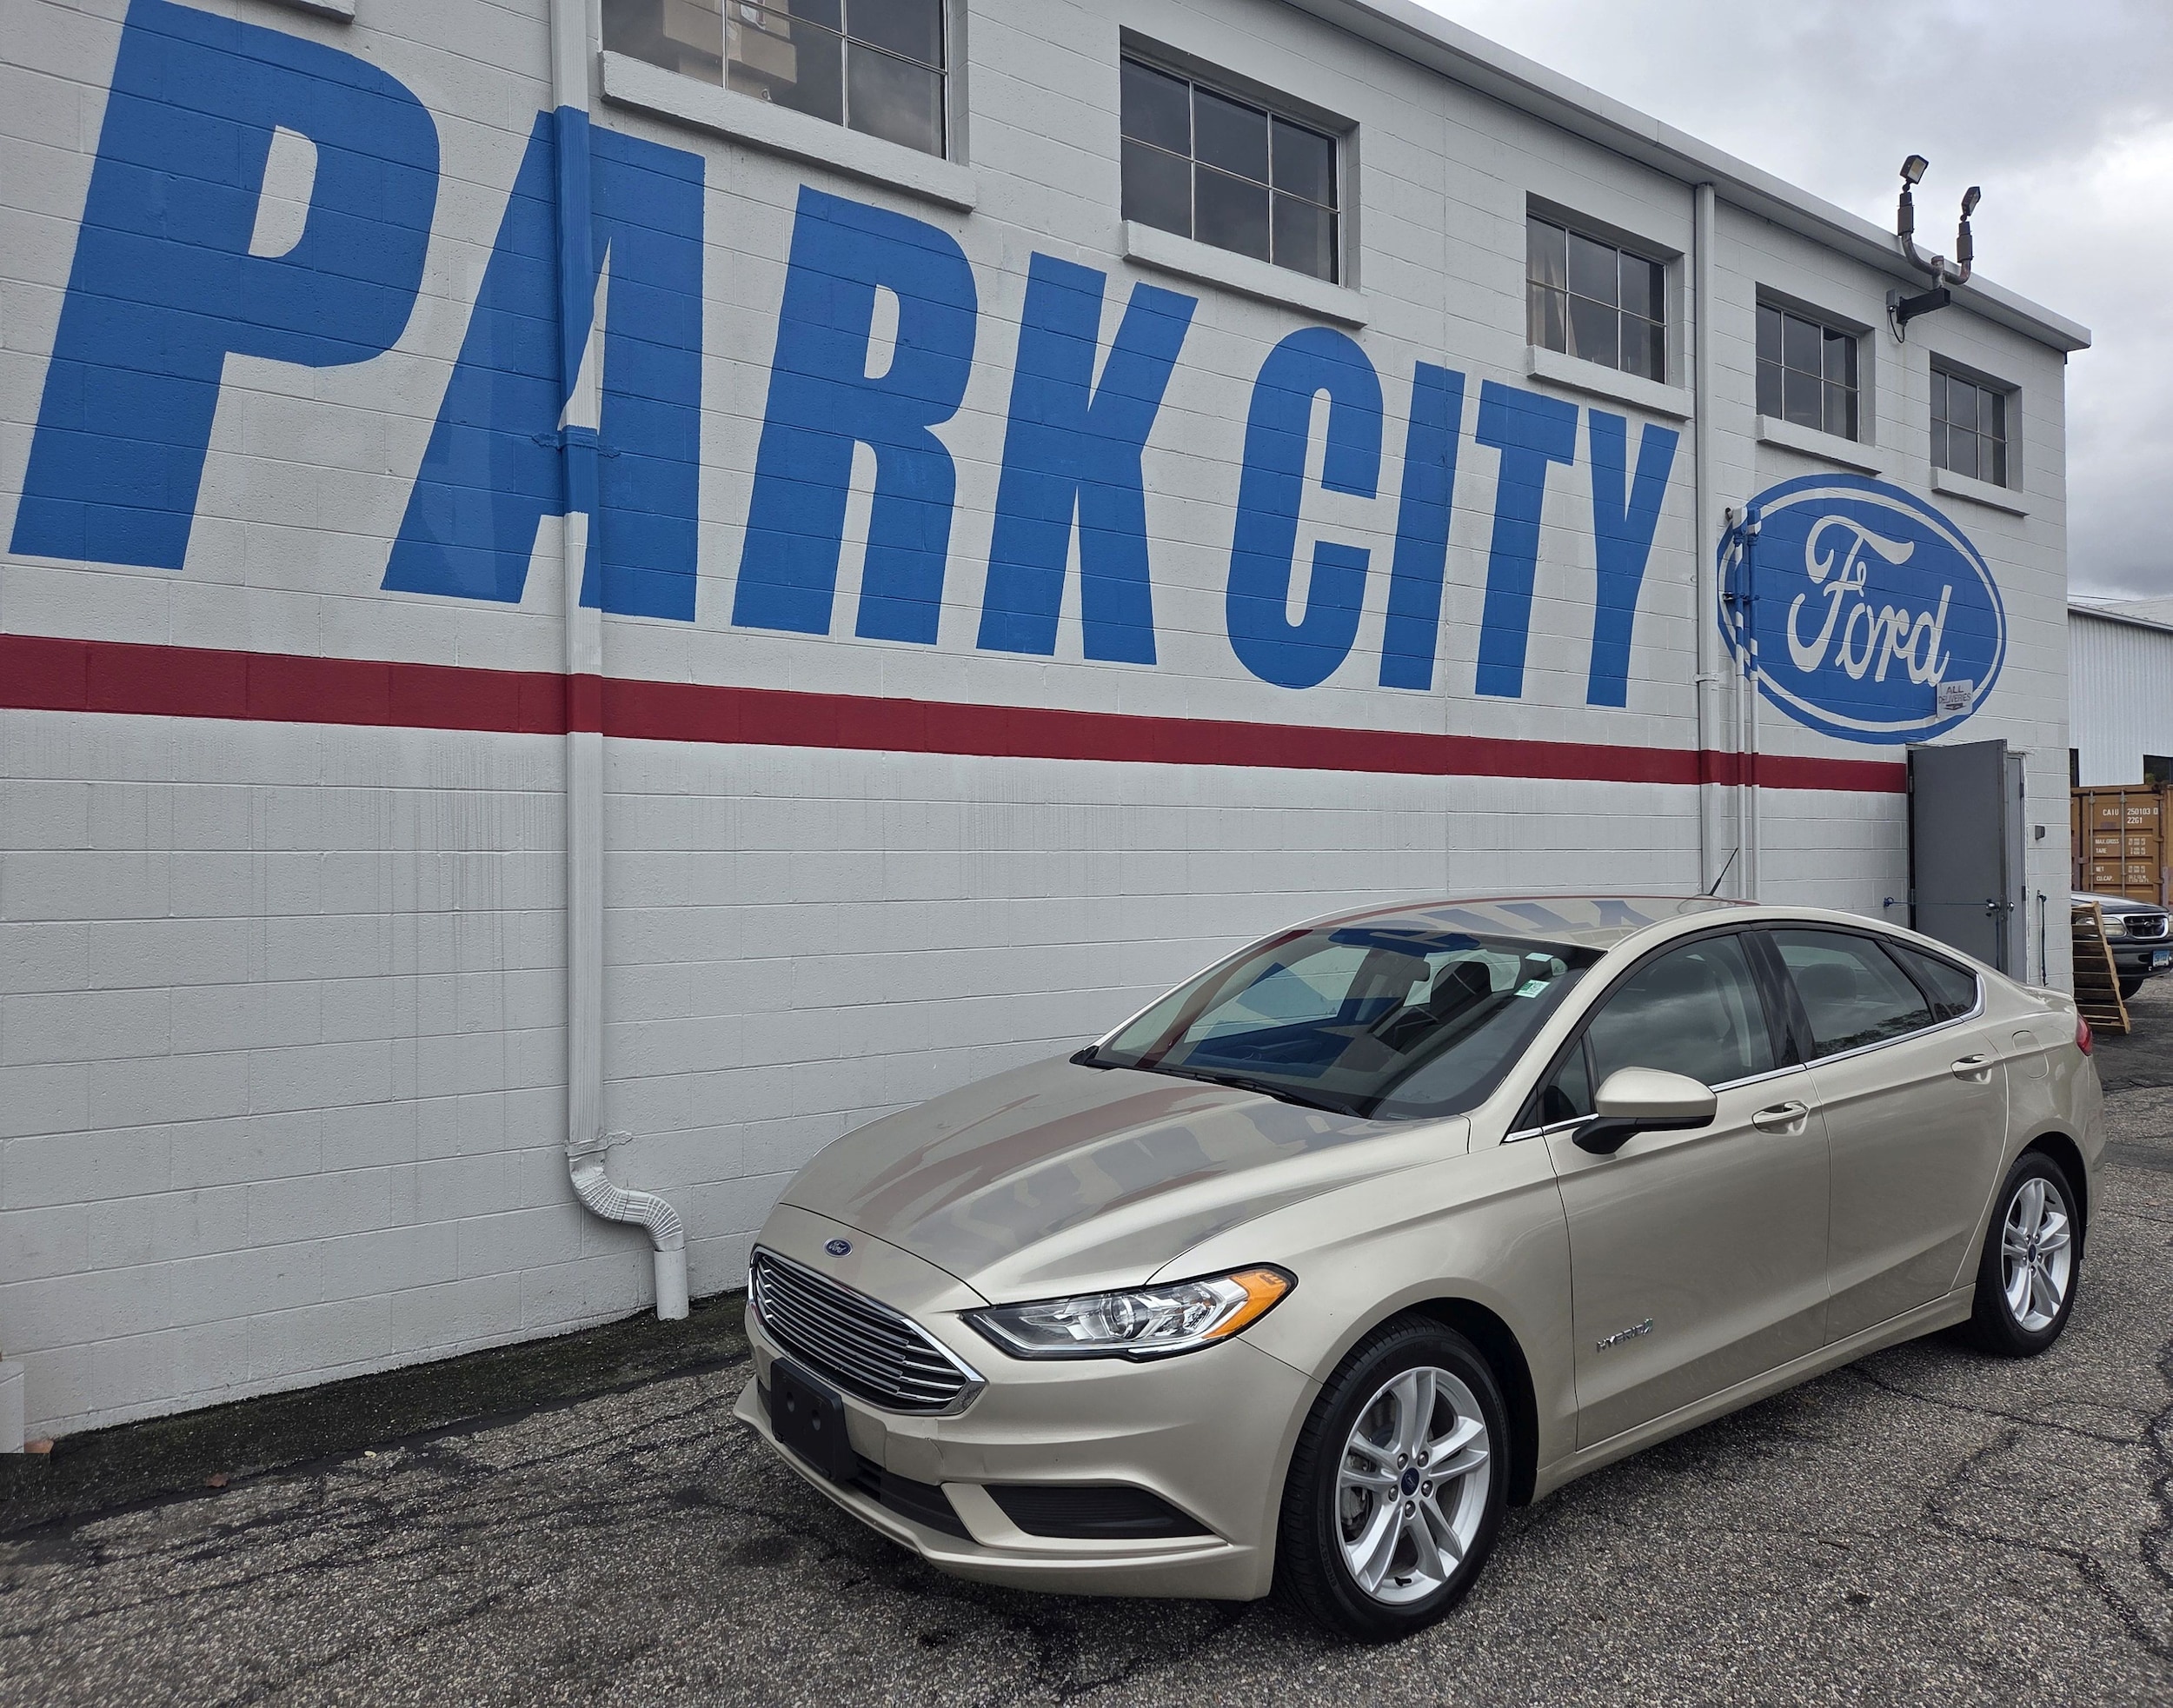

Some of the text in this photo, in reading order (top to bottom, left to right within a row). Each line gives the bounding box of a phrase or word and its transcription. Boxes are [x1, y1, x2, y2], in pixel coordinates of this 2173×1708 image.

[9, 0, 1679, 708] PARK CITY
[1787, 515, 1952, 687] Ford
[1938, 693, 1972, 704] DELIVERIES
[1946, 685, 1964, 694] ALL
